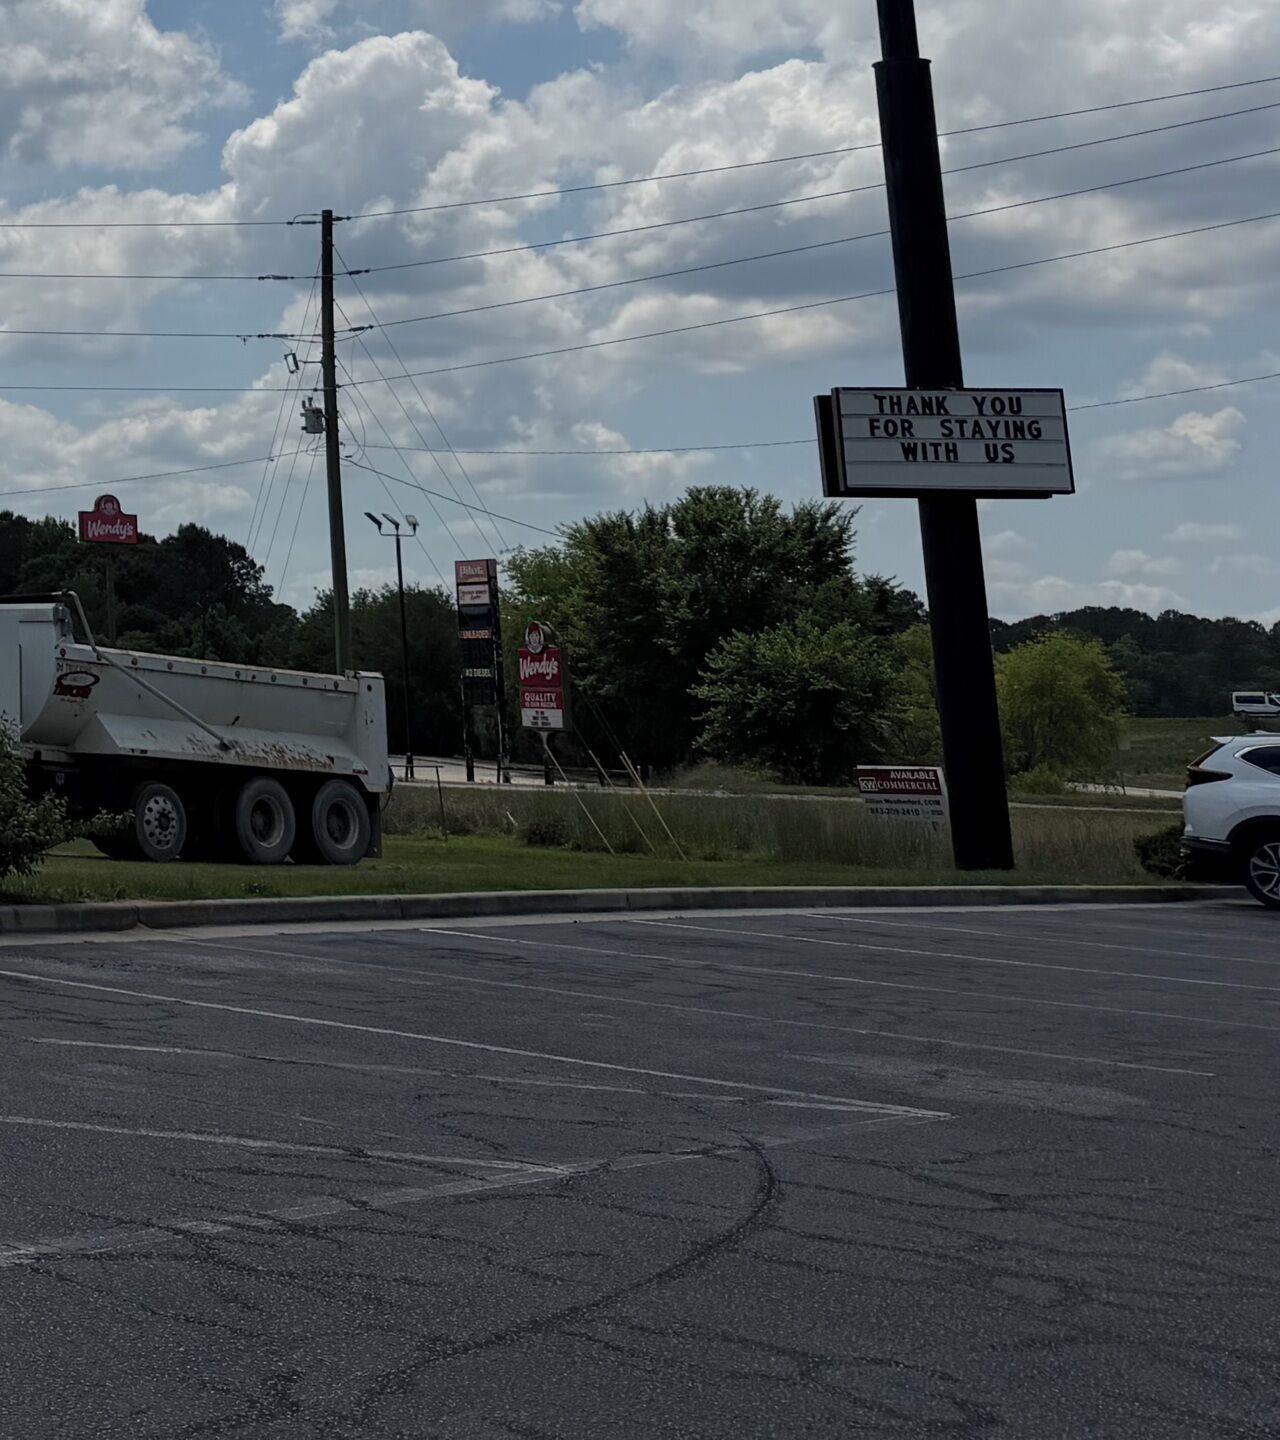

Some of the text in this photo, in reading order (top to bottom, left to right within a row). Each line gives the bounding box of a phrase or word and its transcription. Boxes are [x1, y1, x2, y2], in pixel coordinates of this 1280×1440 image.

[873, 393, 1023, 415] THANK YOU
[868, 418, 1043, 440] FOR STAYING
[900, 441, 1016, 464] WITH US
[87, 520, 134, 540] Wendy's
[459, 565, 484, 578] Pilot
[519, 654, 559, 680] Wendy's
[524, 692, 557, 702] QUALITY
[890, 770, 936, 780] AVAILABLE
[877, 781, 939, 791] COMMERCIAL
